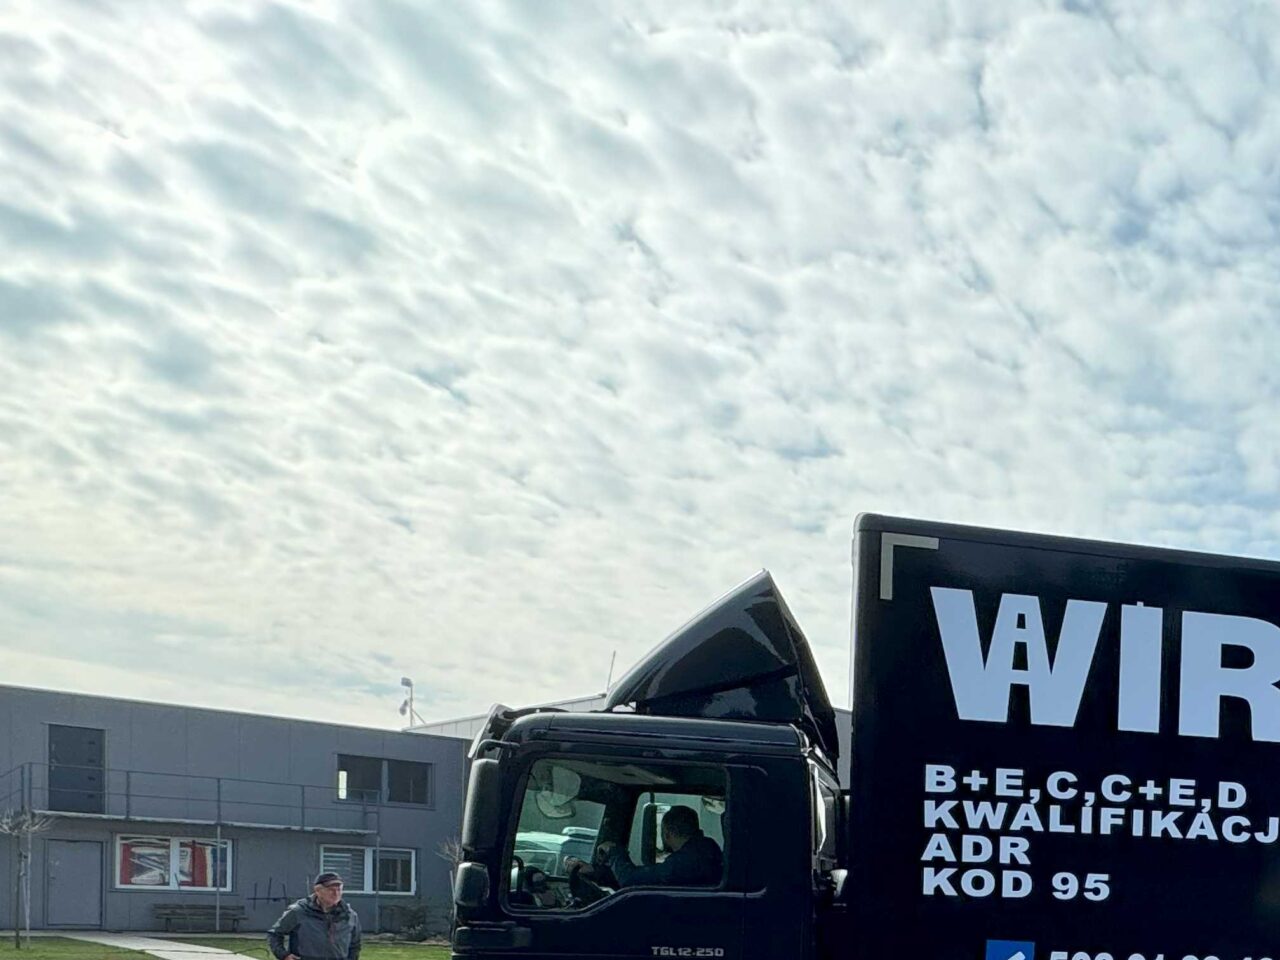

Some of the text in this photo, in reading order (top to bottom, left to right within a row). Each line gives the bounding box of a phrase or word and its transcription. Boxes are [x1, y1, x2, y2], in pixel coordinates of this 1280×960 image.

[920, 833, 1031, 865] ADR
[922, 867, 1111, 901] KOD 95
